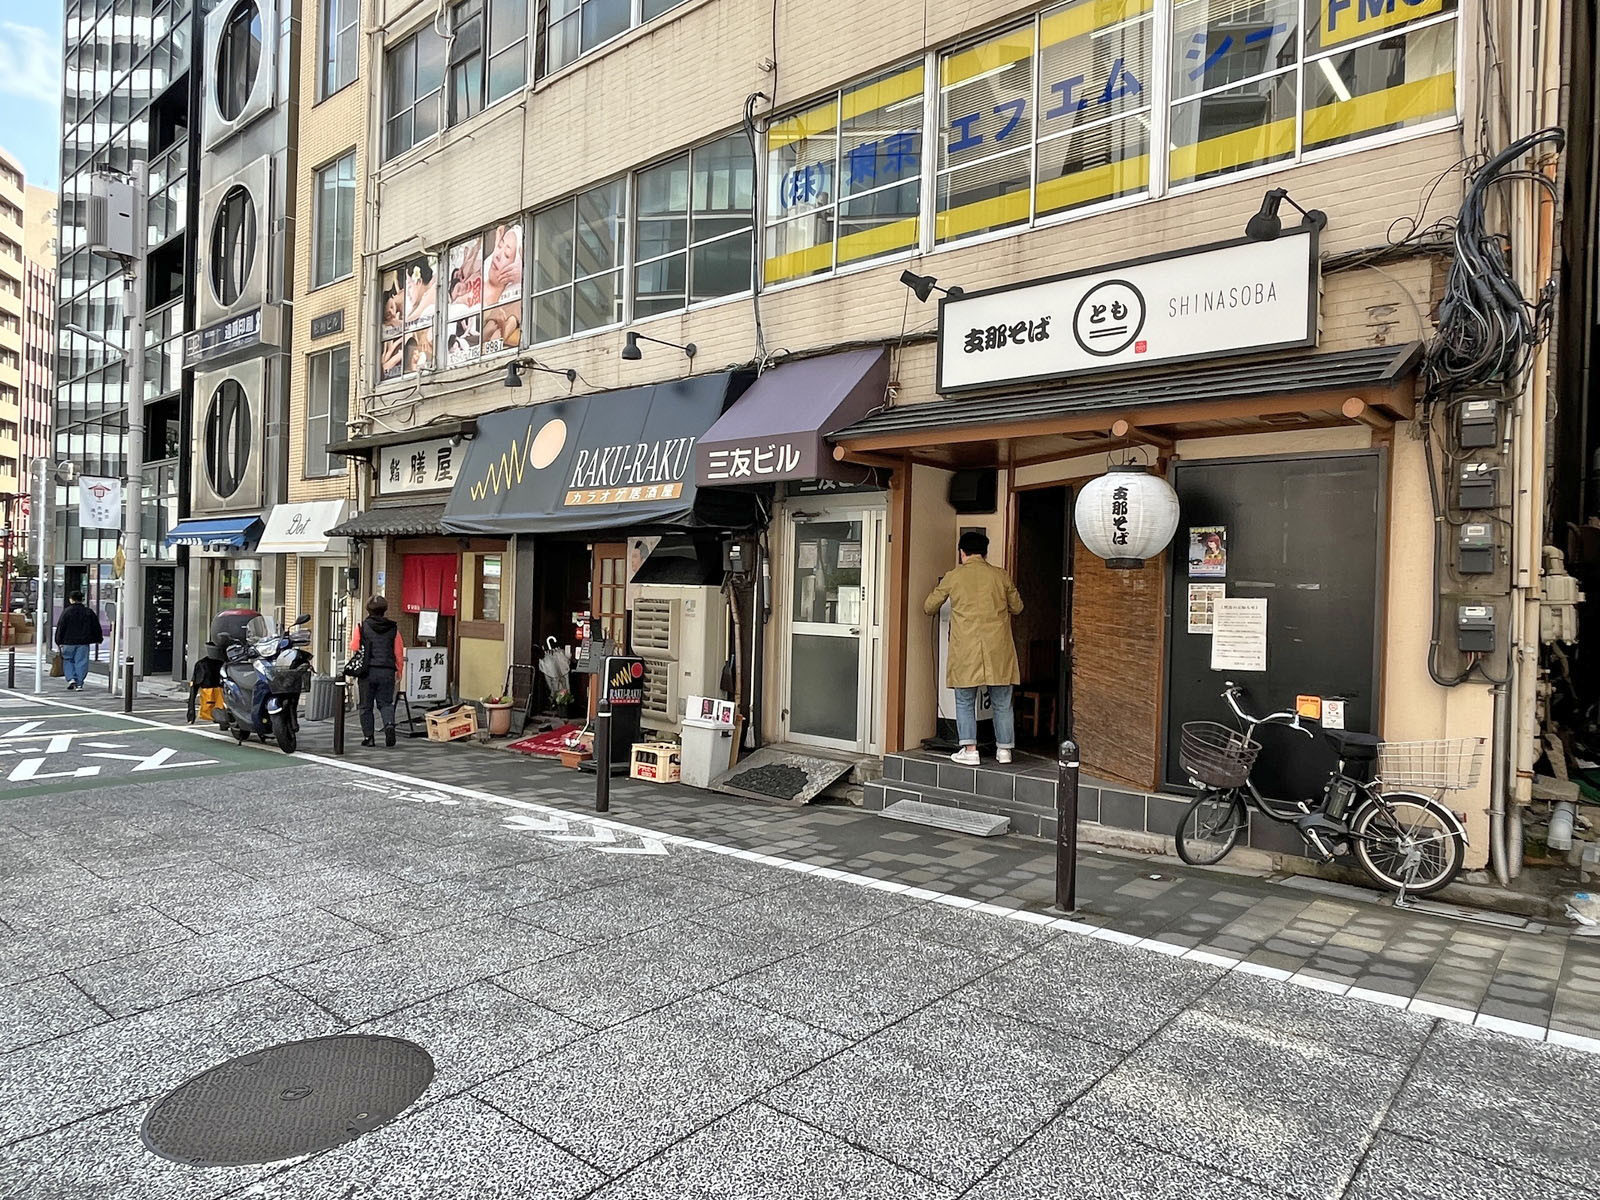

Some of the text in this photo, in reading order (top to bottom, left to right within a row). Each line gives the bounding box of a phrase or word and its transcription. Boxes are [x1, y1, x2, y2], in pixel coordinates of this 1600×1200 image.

[1089, 299, 1129, 324] とも
[1168, 281, 1277, 319] SHINASOBA
[963, 315, 1051, 354] 支那そば
[569, 436, 696, 488] RAKU-RAKU
[707, 443, 801, 480] 三友ビル
[571, 486, 675, 504] カラオケ居酒屋
[1111, 486, 1130, 546] 支那そば
